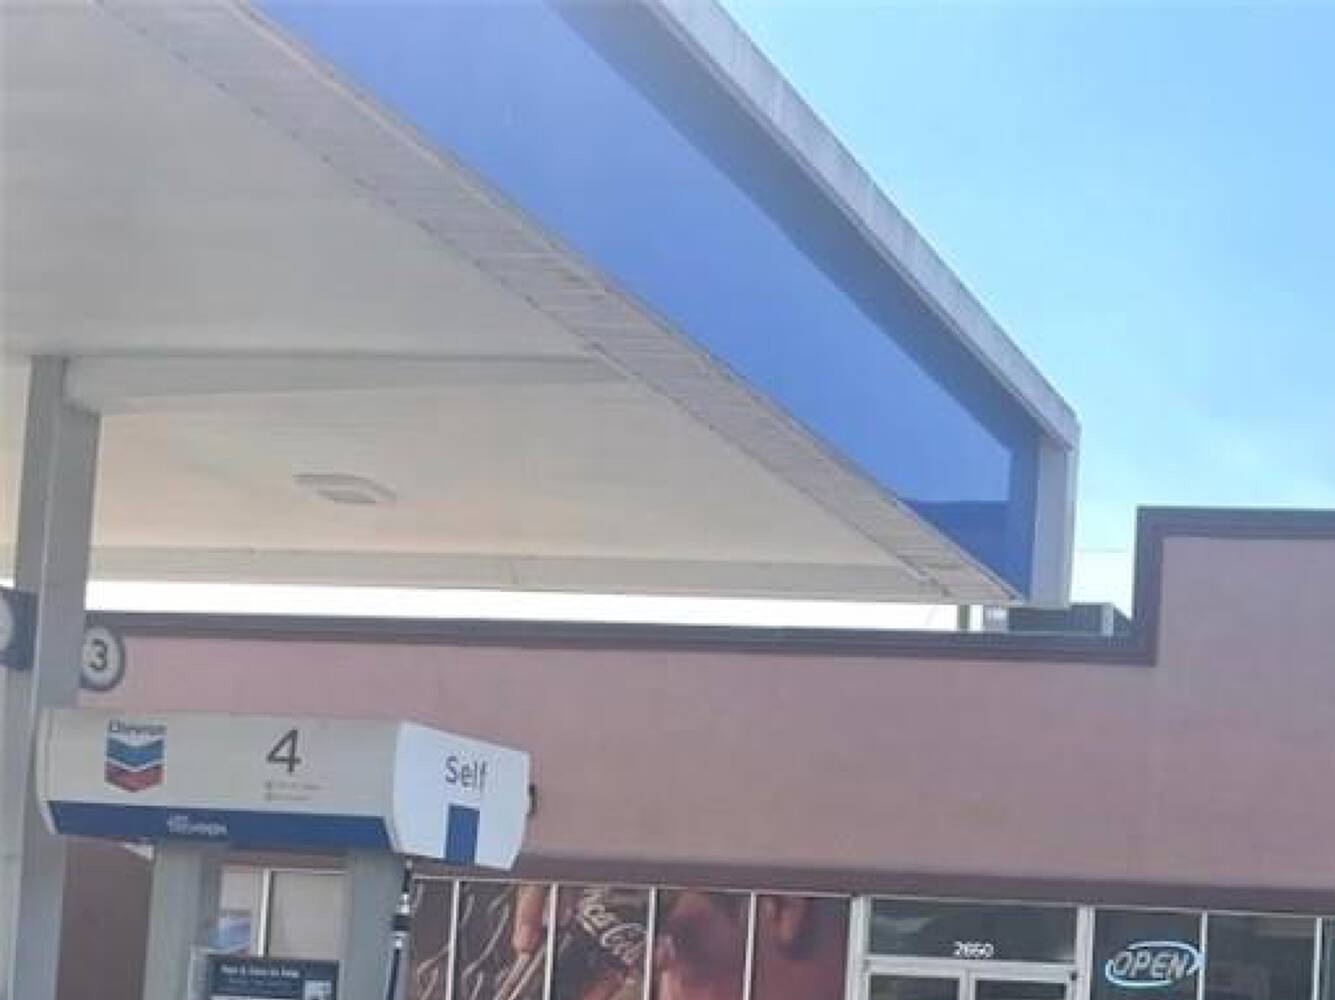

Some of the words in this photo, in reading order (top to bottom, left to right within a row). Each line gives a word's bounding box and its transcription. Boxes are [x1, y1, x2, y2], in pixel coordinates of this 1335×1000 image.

[88, 638, 108, 671] 3
[266, 728, 302, 774] 4
[445, 755, 487, 792] Self
[1112, 950, 1190, 979] OPEN
